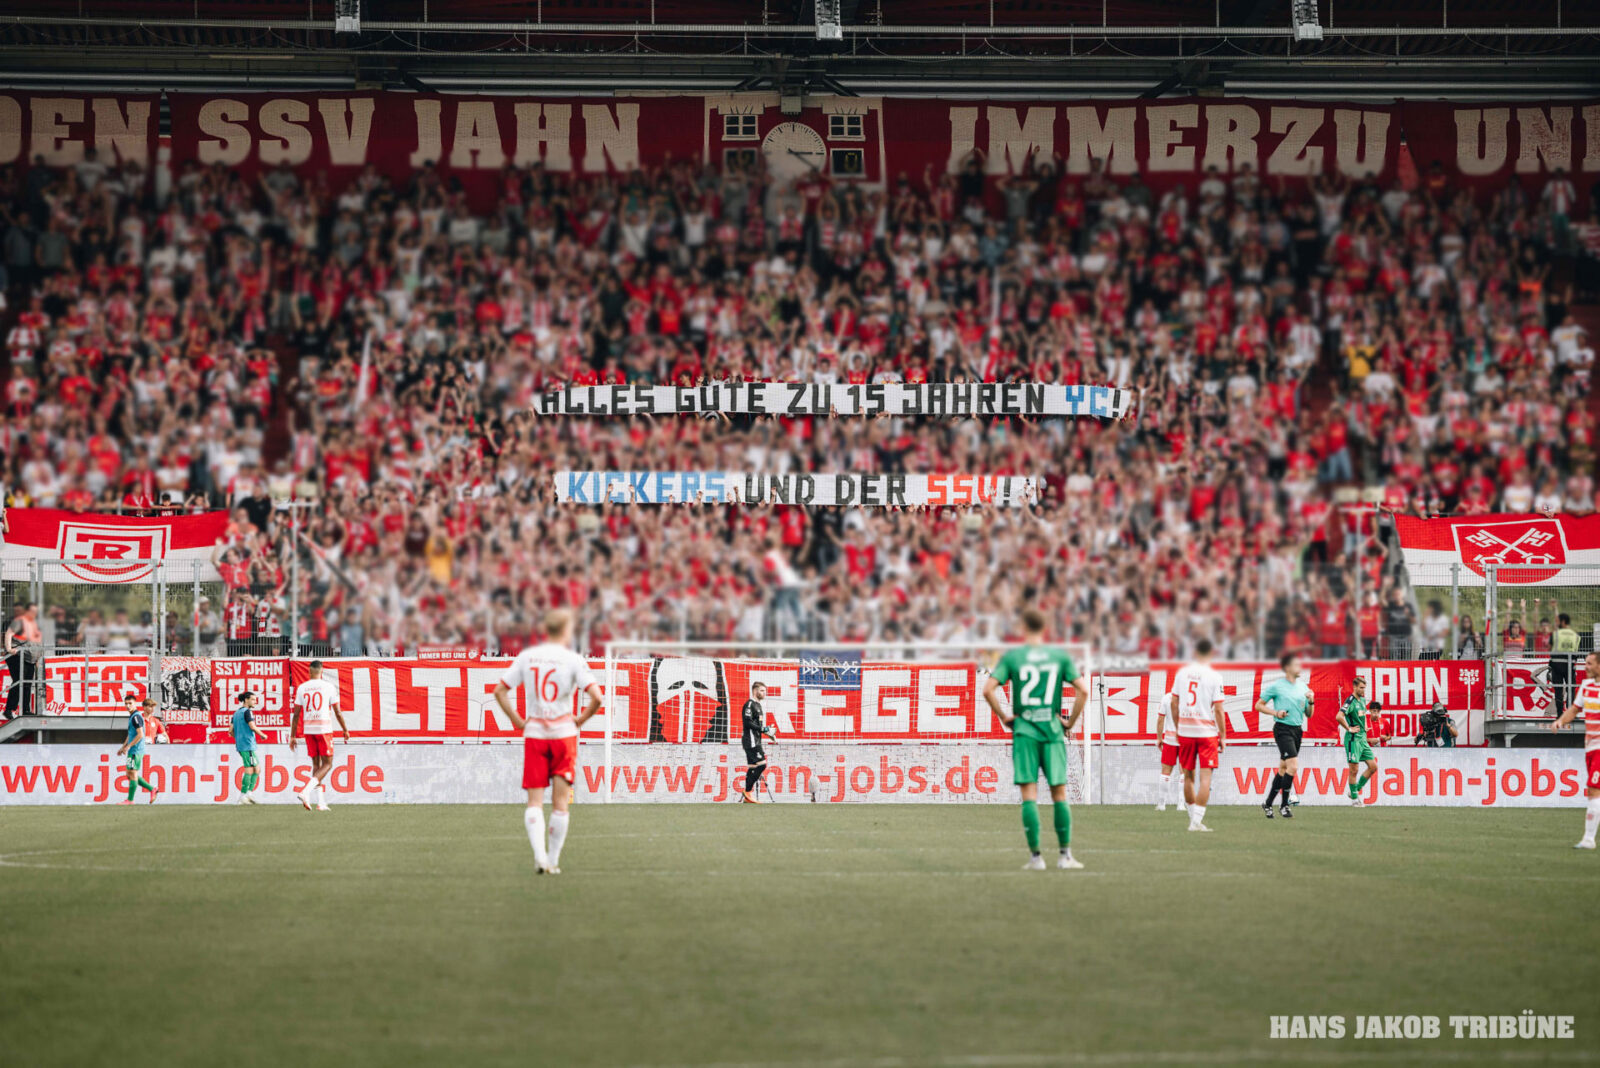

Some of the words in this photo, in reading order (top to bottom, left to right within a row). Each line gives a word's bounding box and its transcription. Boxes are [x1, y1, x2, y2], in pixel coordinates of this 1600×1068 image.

[198, 98, 374, 165] SSV
[410, 99, 639, 172] JAHN
[947, 103, 1391, 177] IMMERZU
[541, 384, 655, 414] ALLES
[675, 382, 766, 412] GUTE
[787, 384, 831, 414] ZU
[847, 385, 885, 414] 15
[903, 384, 1045, 415] JAHREN
[568, 472, 726, 502] KICKERS
[745, 474, 815, 505] UND
[835, 475, 906, 505] DER
[215, 662, 242, 676] SSV
[246, 662, 283, 675] JAHN
[529, 667, 558, 703] 16
[1020, 663, 1059, 706] 27
[215, 678, 283, 711] 1889
[303, 692, 323, 713] 20
[321, 667, 630, 733] ULTRS
[749, 668, 1312, 734] REGENBR
[1186, 681, 1198, 707] 5
[1356, 667, 1449, 706] JAHN
[215, 714, 284, 727] REBURG
